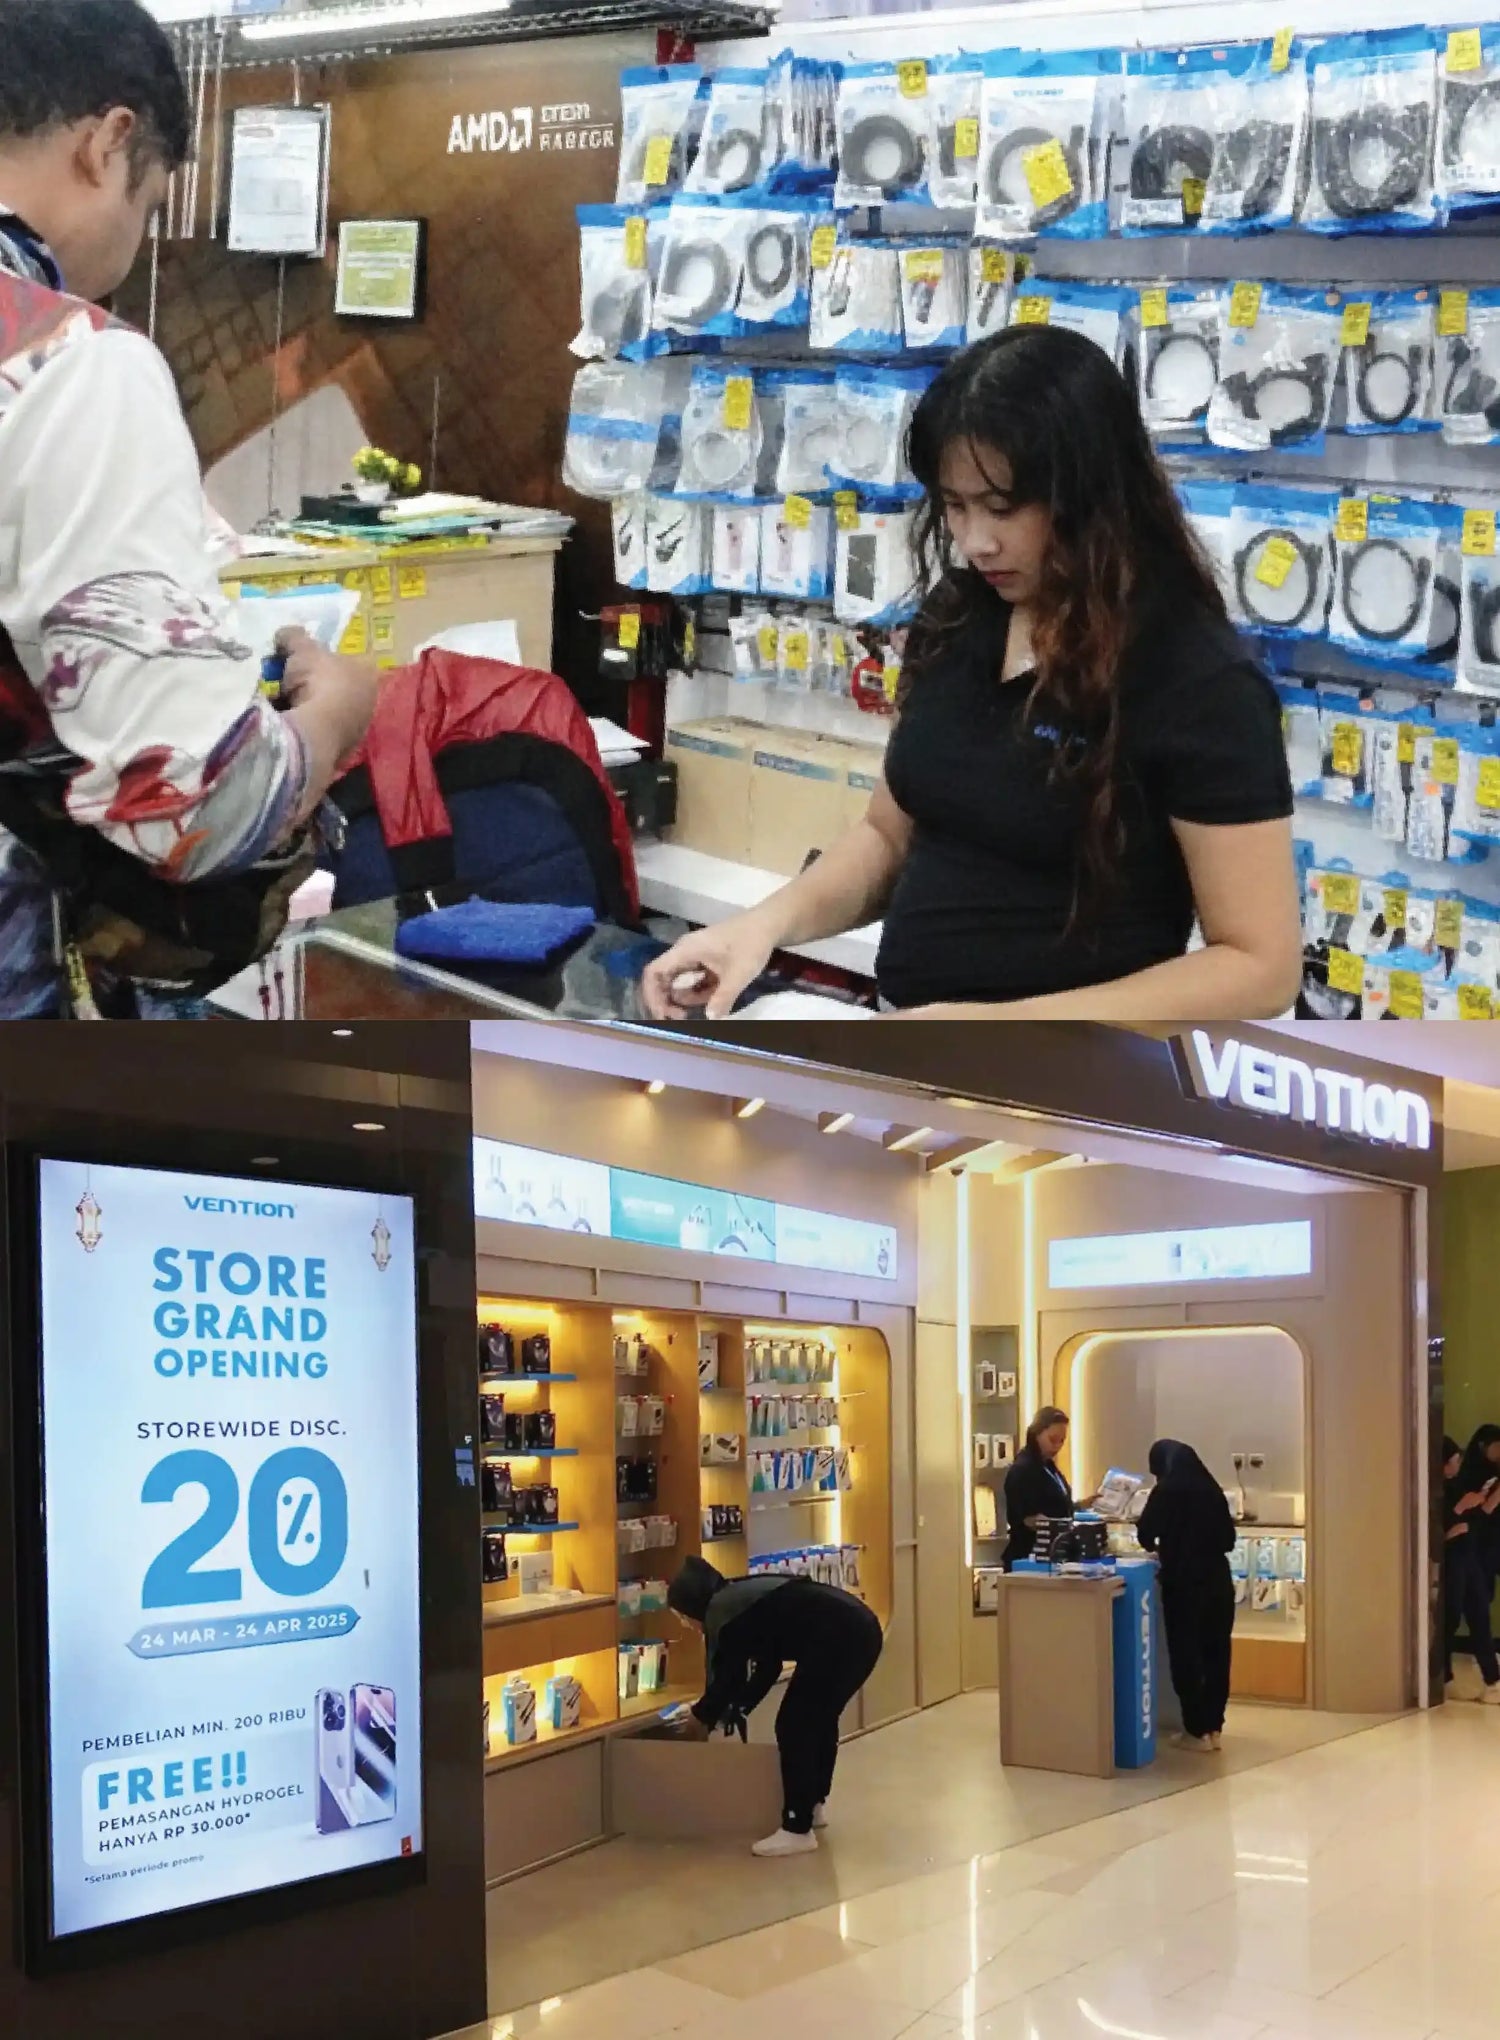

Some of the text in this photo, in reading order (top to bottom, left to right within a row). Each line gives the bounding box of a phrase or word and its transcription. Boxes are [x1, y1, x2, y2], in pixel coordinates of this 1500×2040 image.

[447, 111, 511, 153] AMD
[1191, 1029, 1431, 1150] VENTION
[184, 1195, 295, 1219] VENTION
[152, 1247, 327, 1299] STORE
[153, 1301, 328, 1342] GRAND
[154, 1348, 329, 1379] OPENING
[137, 1420, 347, 1439] STOREWIDE DISC.
[140, 1634, 165, 1649] 24
[173, 1628, 216, 1646] MAR
[236, 1623, 258, 1639] 24
[264, 1617, 301, 1635] APR
[307, 1612, 348, 1630] 2025
[82, 1708, 307, 1752] PEMBELIAN MIN. 200 RIBU
[98, 1751, 248, 1811] FREE!!
[98, 1784, 305, 1832] PEMASANGAN HYDROGEL
[98, 1832, 158, 1853] HANYA
[163, 1826, 186, 1840] RP
